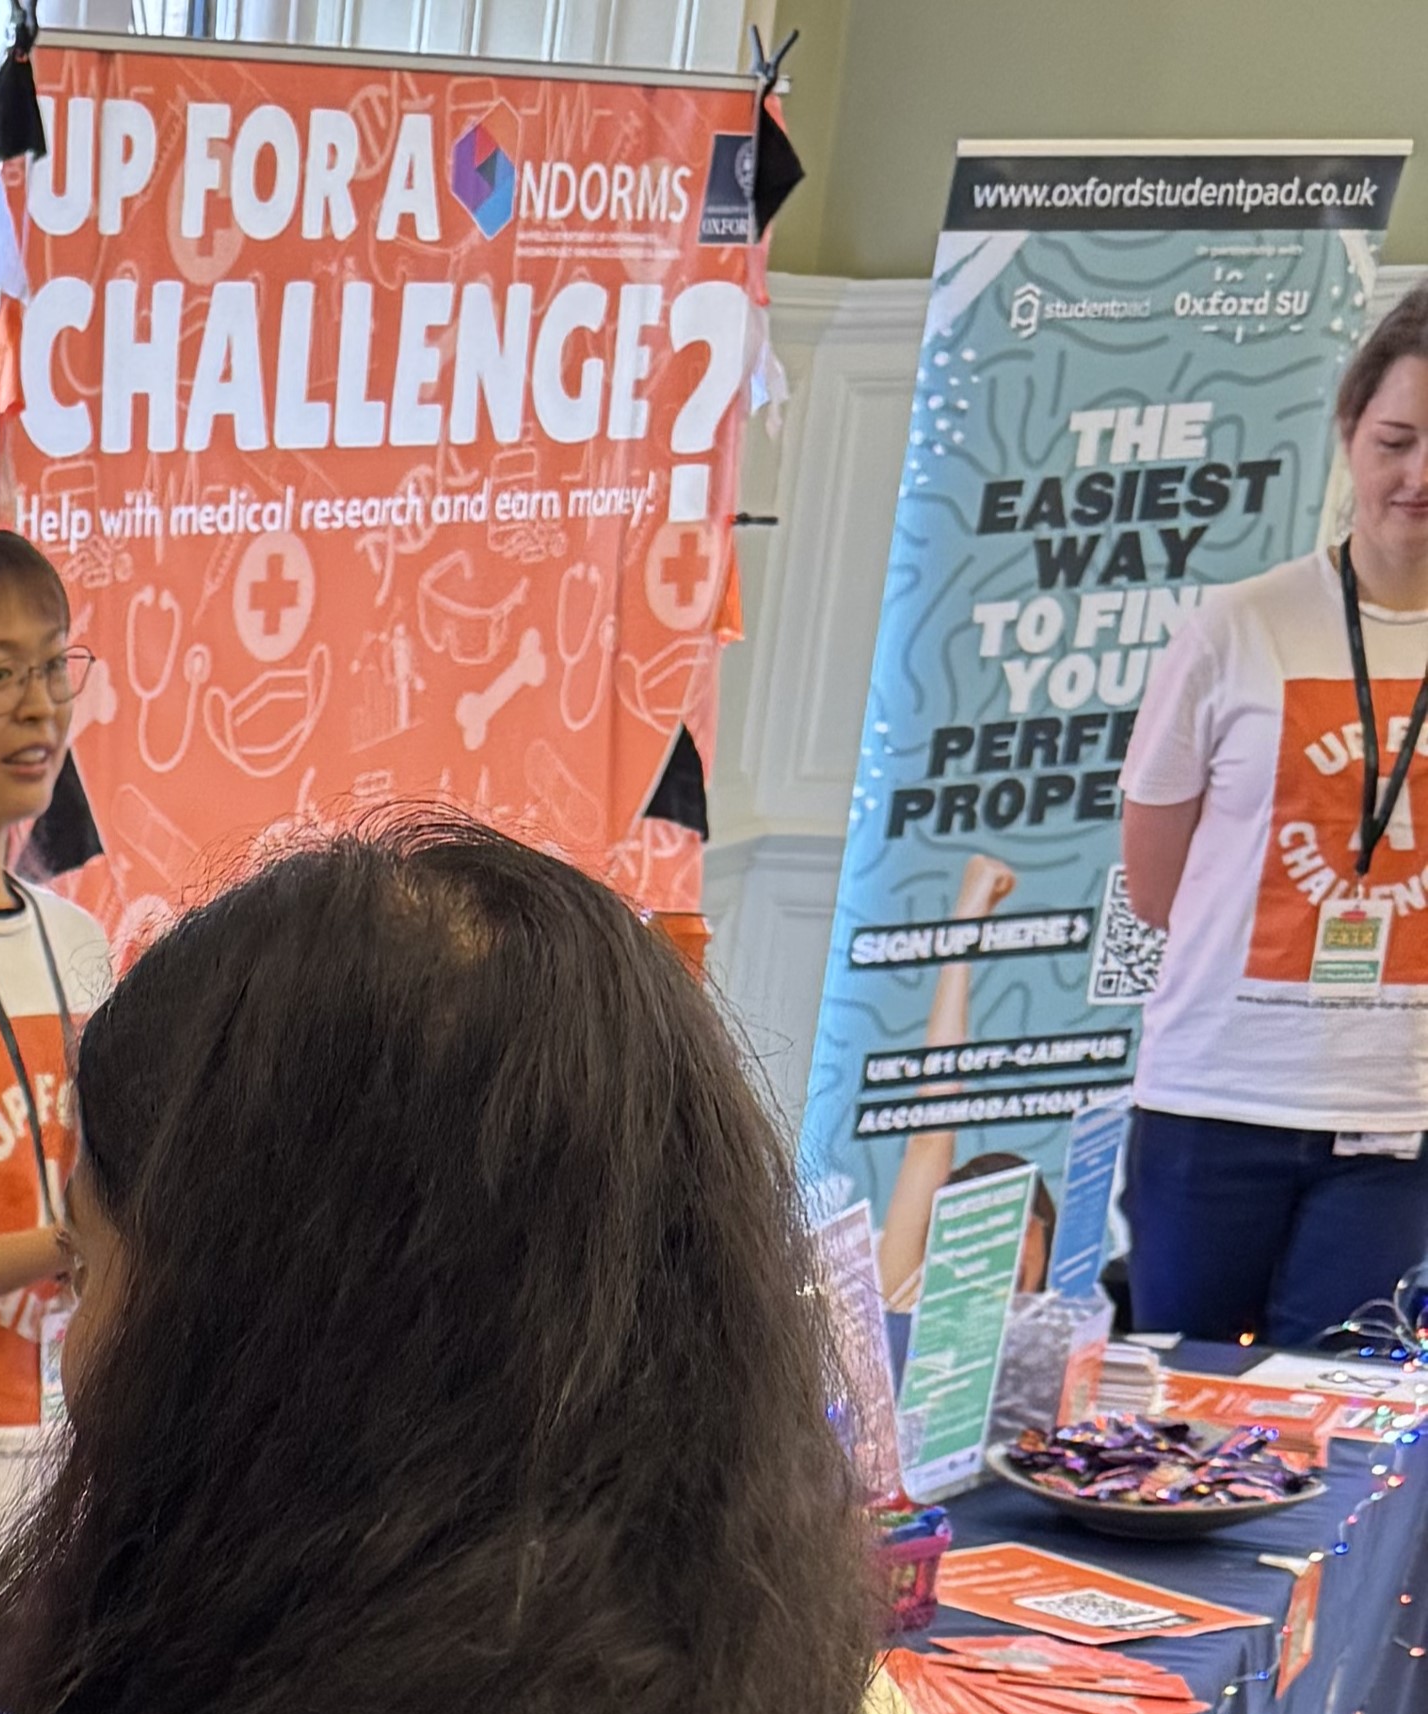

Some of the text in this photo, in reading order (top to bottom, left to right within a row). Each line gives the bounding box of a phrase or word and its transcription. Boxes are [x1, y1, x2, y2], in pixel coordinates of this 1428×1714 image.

[27, 95, 440, 242] UP FOR A
[519, 160, 692, 224] NDORMS
[973, 177, 1380, 212] www.oxfordstudentpad.co.uk
[701, 217, 750, 236] OXFOR
[1044, 298, 1151, 320] studentpad
[1174, 291, 1309, 317] Oxford SU
[20, 276, 750, 523] CHALLENGE?
[1069, 402, 1214, 467] THE
[16, 470, 658, 555] Help with medical research and earn money!
[977, 459, 1282, 535] EASIEST
[1033, 526, 1209, 589] WAY
[973, 585, 1204, 657] TO FIN
[1002, 648, 1167, 714] YOU
[927, 709, 1140, 778] PERFE
[885, 769, 1124, 839] PROPE
[851, 930, 932, 964] SIGN
[934, 924, 980, 957] UP
